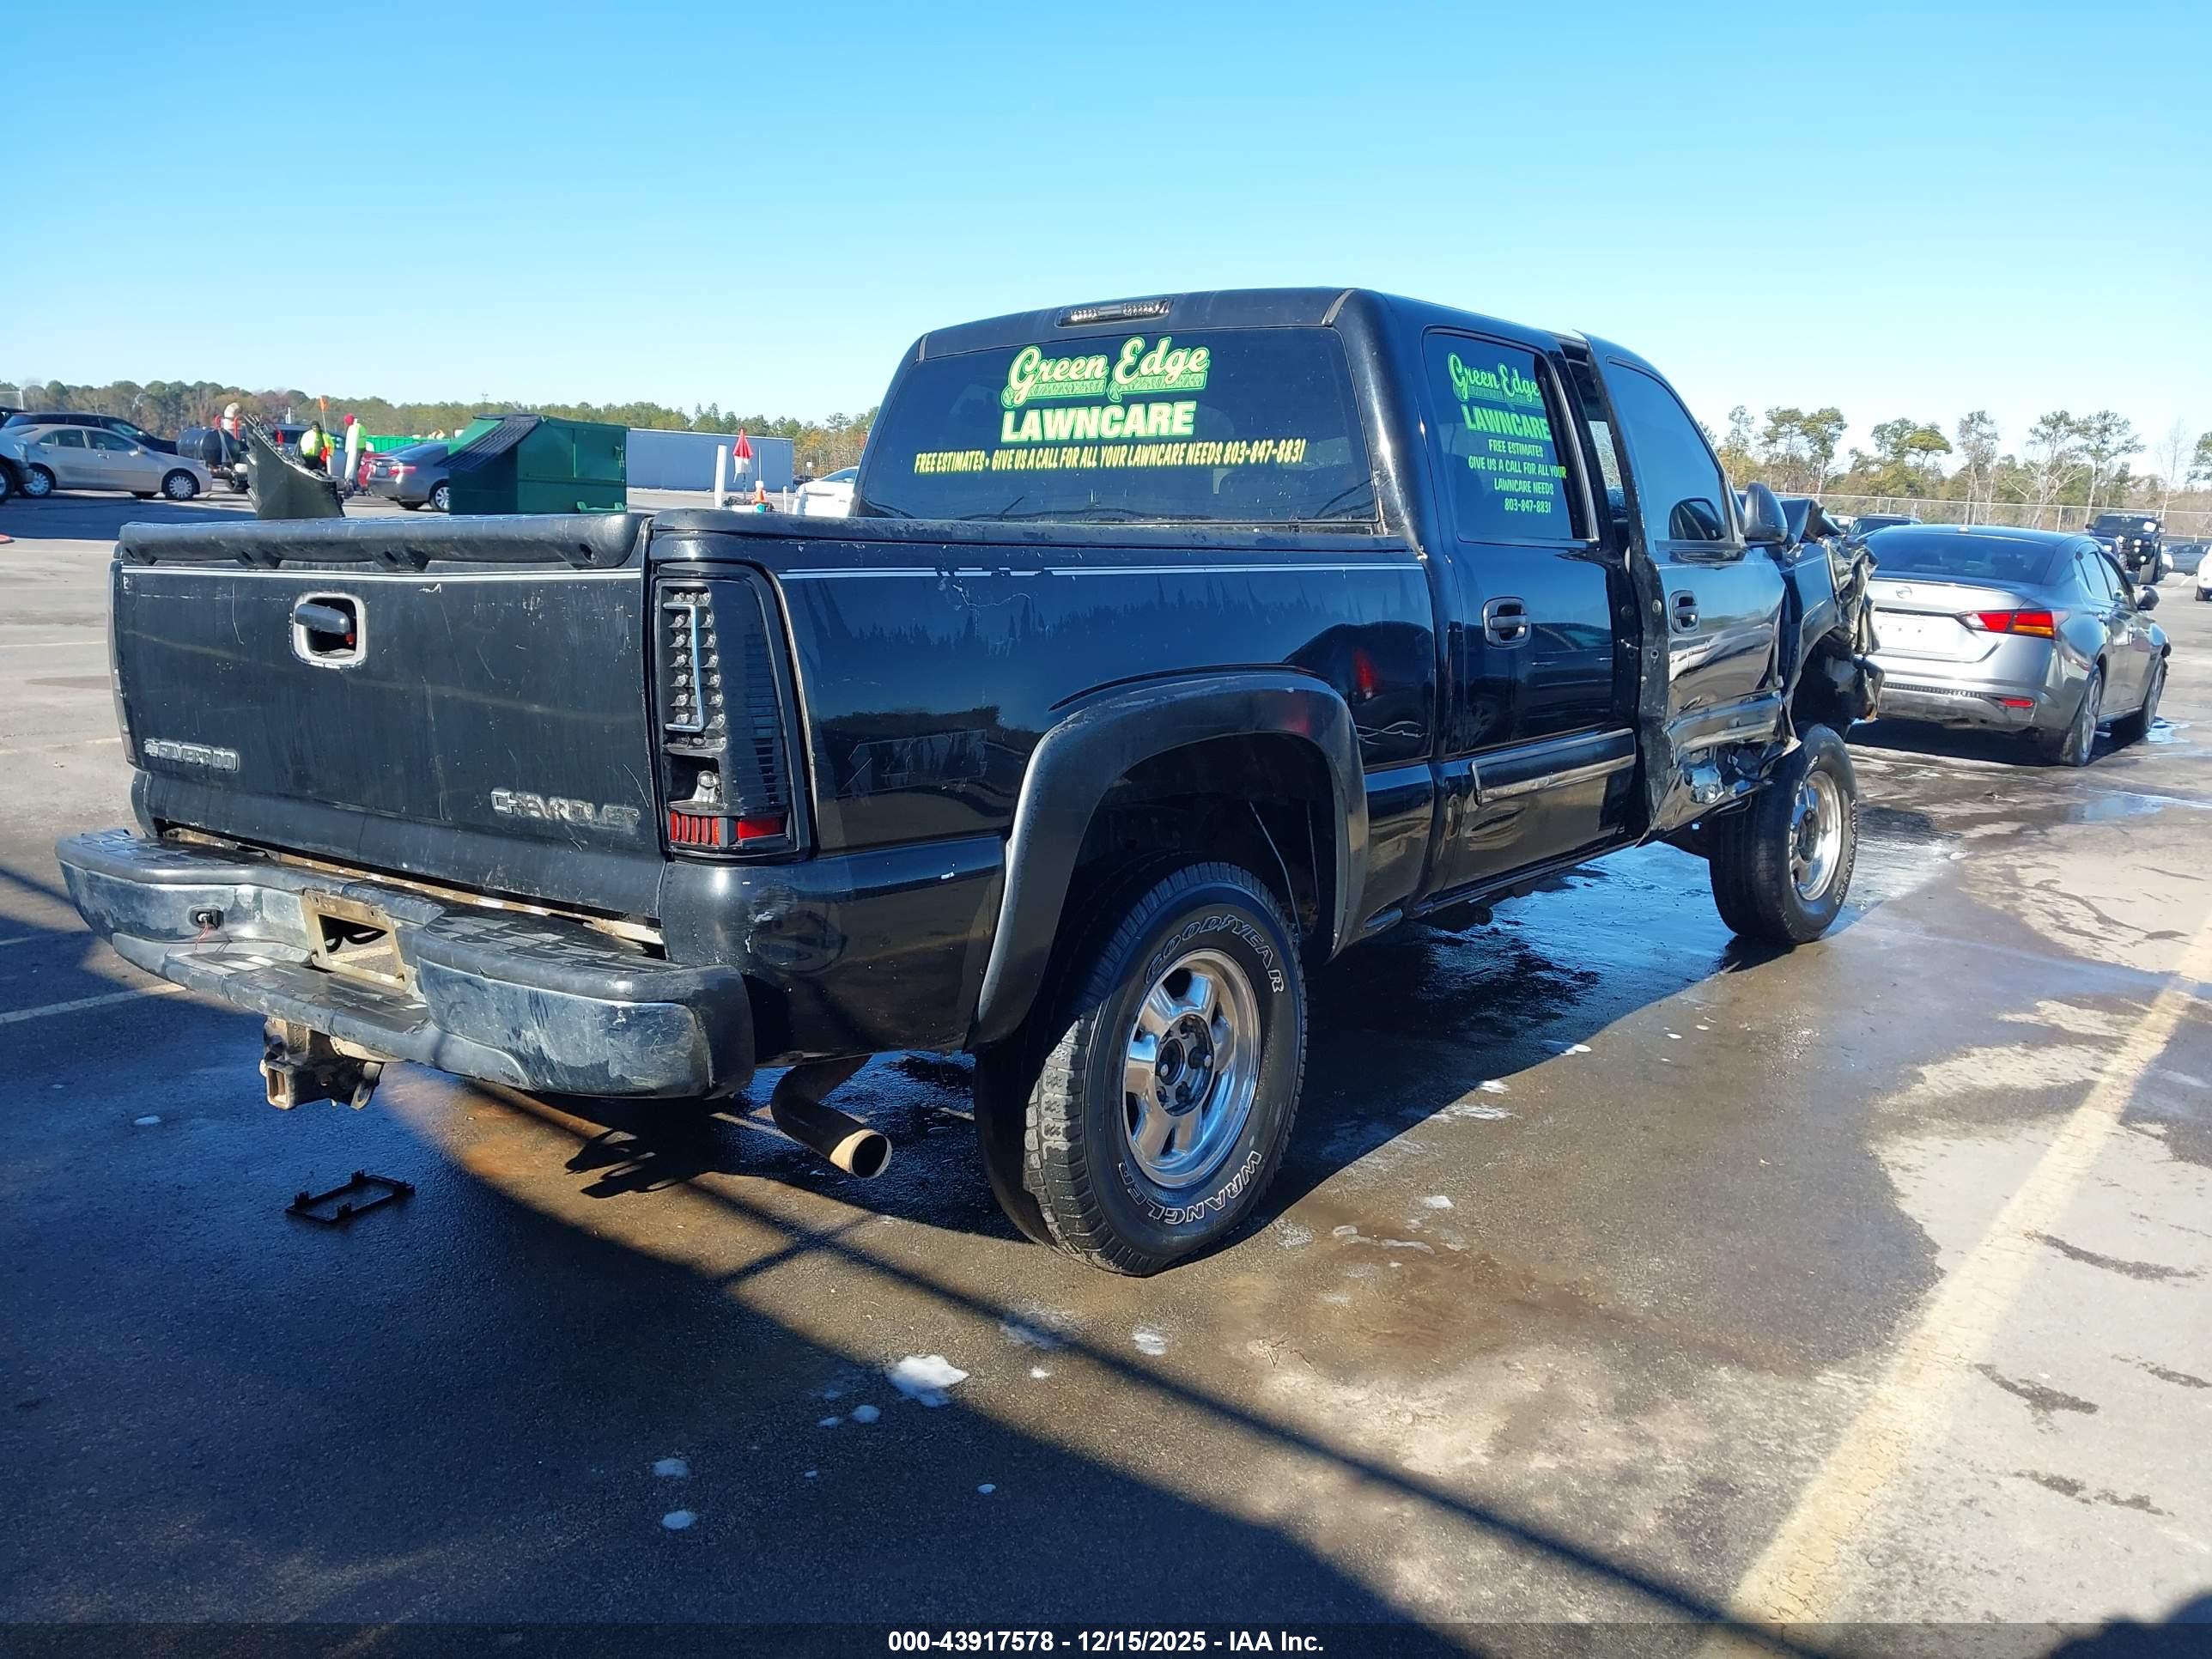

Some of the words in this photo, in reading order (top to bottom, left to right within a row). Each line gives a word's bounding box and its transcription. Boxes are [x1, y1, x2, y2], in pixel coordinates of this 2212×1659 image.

[1006, 345, 1109, 406] Green
[1111, 336, 1210, 386] Edge
[1448, 352, 1500, 400] Green
[1498, 363, 1541, 402] Edge
[1001, 401, 1196, 442] LAWNCARE
[1461, 404, 1552, 441] LAWNCARE
[915, 452, 938, 473] FREE
[992, 449, 1014, 471] GIVE
[1014, 448, 1028, 471] US
[1028, 447, 1036, 470] A
[1036, 447, 1059, 469] CALL
[1060, 446, 1079, 468] FOR
[1079, 446, 1098, 468] ALL
[1100, 445, 1128, 468] YOUR
[1127, 443, 1188, 466] LAWNCARE
[1186, 441, 1224, 465] NEEDS
[1223, 439, 1306, 464] 803-847-8831
[1488, 439, 1506, 453] FREE
[1508, 441, 1544, 458] ESTIMATES
[1468, 456, 1486, 470] GIVE
[1486, 458, 1497, 471] US
[1498, 459, 1504, 472] A
[1505, 460, 1522, 473] CALL
[1523, 462, 1537, 475] FOR
[1537, 464, 1549, 477] ALL
[1550, 465, 1567, 479] YOUR
[1494, 478, 1532, 494] LAWNCARE
[1533, 481, 1554, 495] NEEDS
[1504, 498, 1552, 514] 803-847-8831
[1146, 914, 1285, 994] GOODYEAR
[1118, 1150, 1262, 1225] WRANGLER
